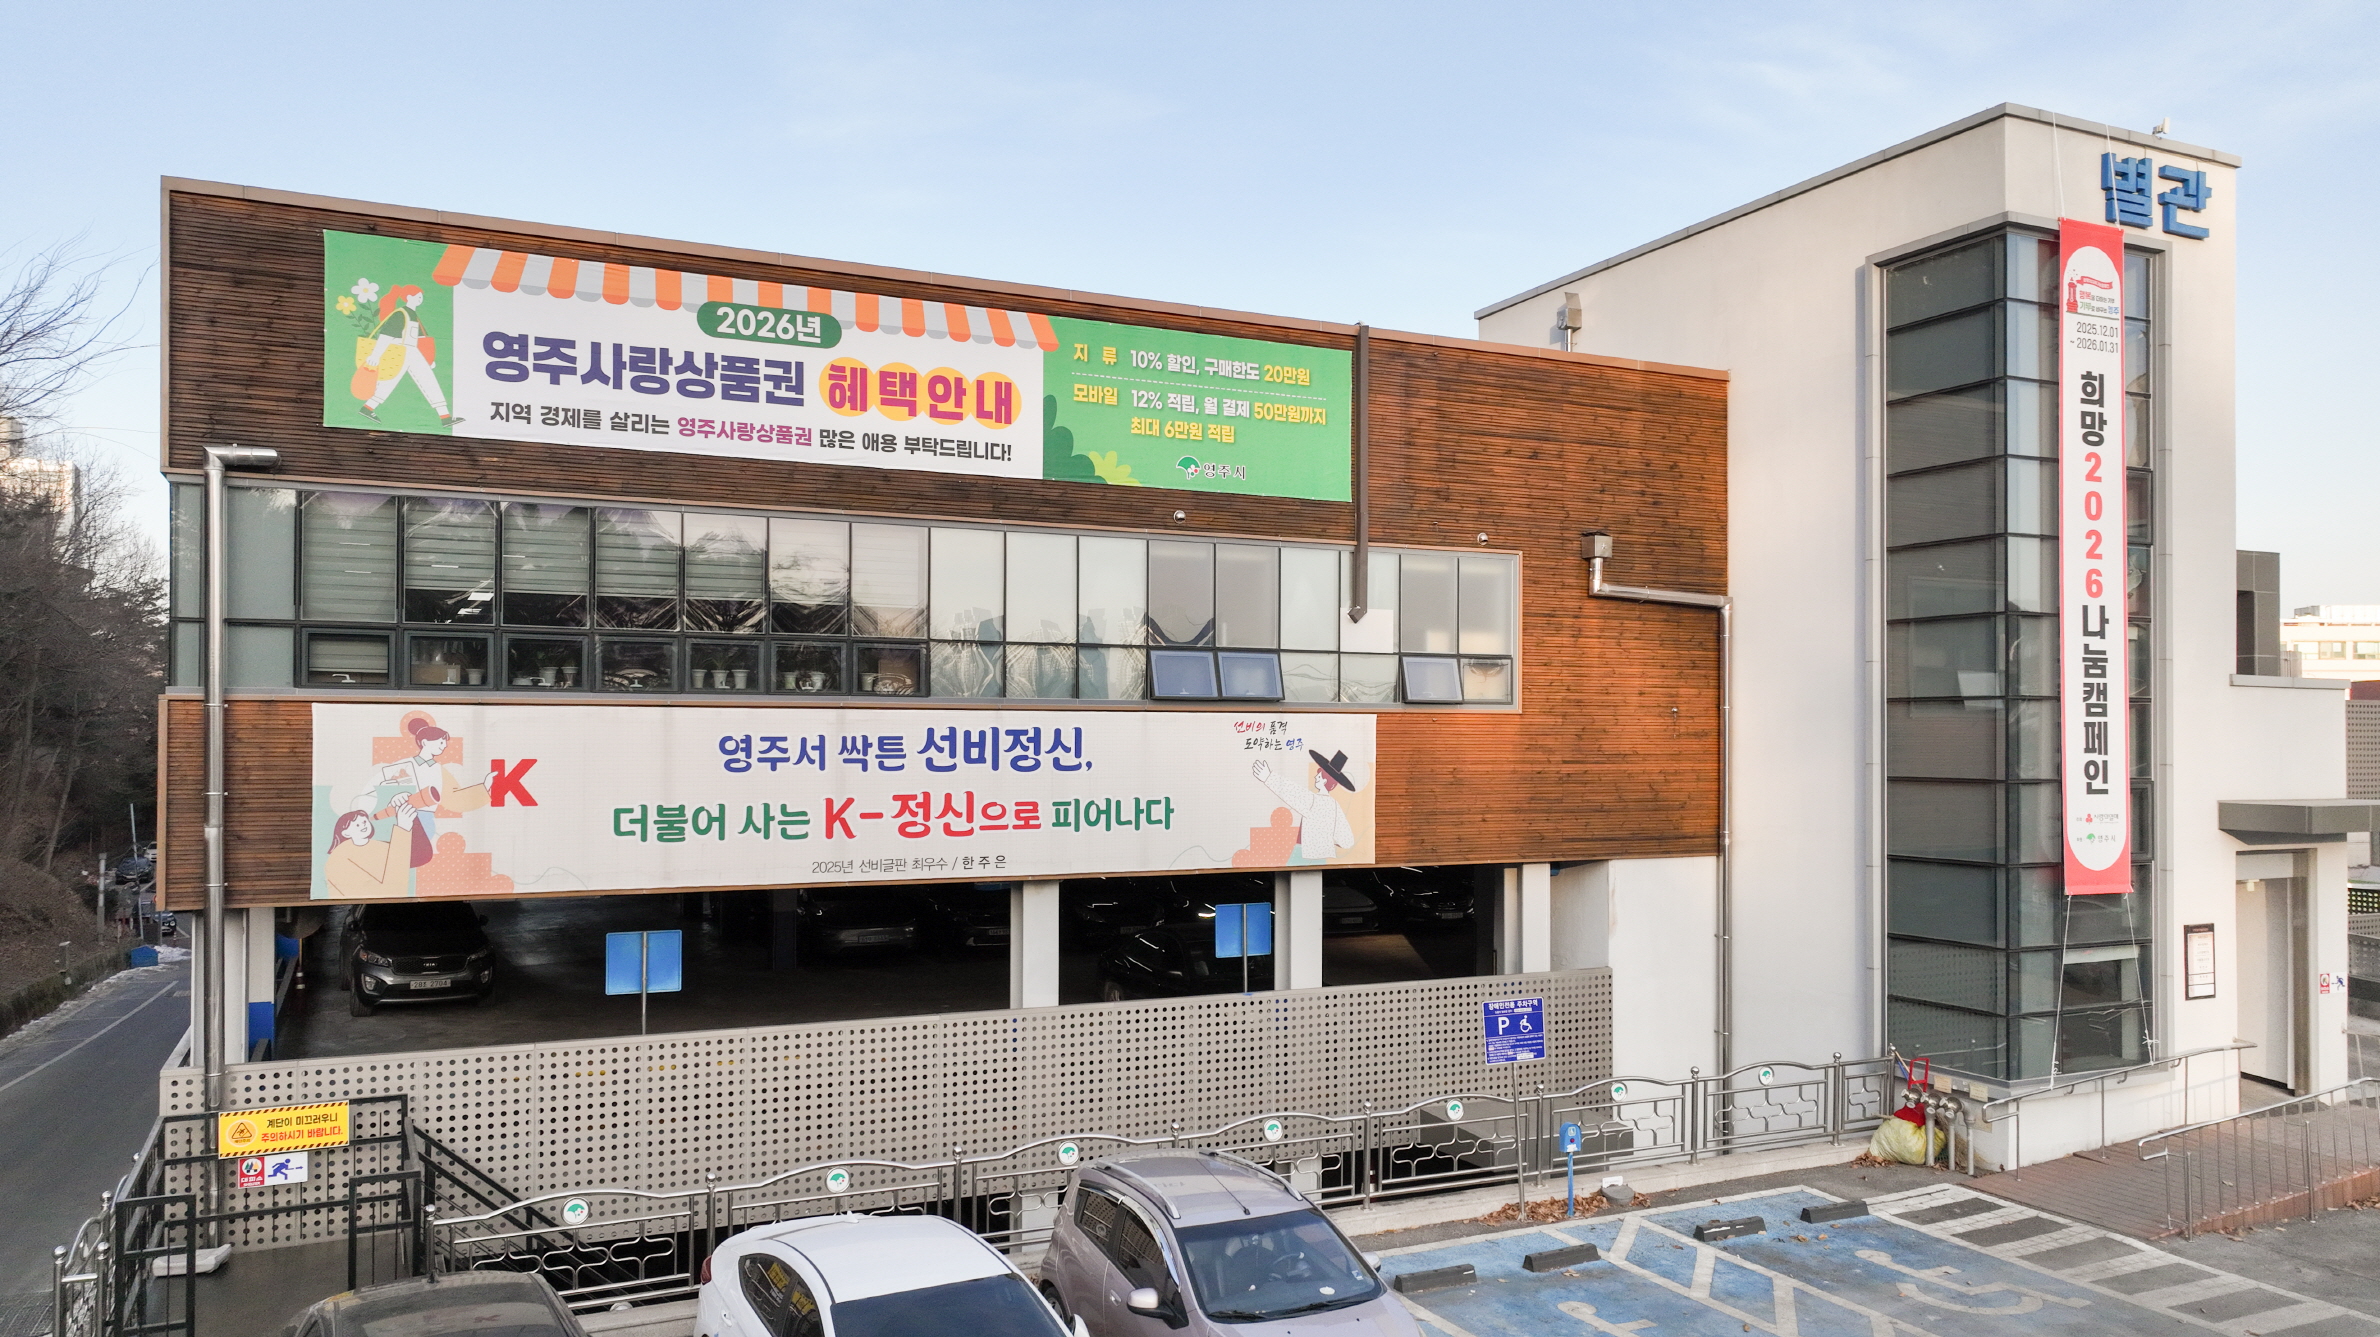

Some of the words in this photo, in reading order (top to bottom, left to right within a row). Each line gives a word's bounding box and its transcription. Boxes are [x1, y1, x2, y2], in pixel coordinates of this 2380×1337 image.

[2101, 152, 2212, 241] 별관
[716, 307, 821, 343] 2026년
[2076, 321, 2118, 338] 2025.12.01
[482, 331, 805, 406] 영주사랑상품권
[1130, 350, 1163, 370] 10%
[1167, 353, 1200, 376] 할인,
[1204, 357, 1260, 380] 구매한도
[1264, 365, 1310, 386] 20만원
[1073, 383, 1118, 406] 모바일
[1131, 389, 1163, 410] 12%
[1167, 392, 1199, 415] 적립,
[1204, 396, 1218, 416] 월
[1222, 398, 1250, 418] 결제
[1254, 402, 1327, 426] 50만원까지
[490, 401, 531, 425] 지역
[540, 405, 602, 430] 경제를
[610, 411, 669, 435] 살리는
[677, 416, 812, 447] 영주사랑상품권
[819, 428, 855, 450] 많은
[862, 432, 897, 452] 애용
[904, 435, 1012, 462] 부탁드립니다!
[1131, 417, 1160, 437] 최대
[1164, 420, 1203, 440] 6만원
[1207, 423, 1235, 443] 적립
[1203, 463, 1246, 480] 영주시
[1233, 721, 1266, 733] 선비의
[1269, 721, 1288, 735] 품격
[718, 734, 826, 773] 영주서
[837, 734, 906, 772] 싹튼
[916, 725, 1093, 773] 선비정신,
[1244, 737, 1282, 751] 도약하는
[1285, 738, 1304, 751] 영주
[491, 758, 538, 807] K
[613, 803, 726, 843] 더불어
[737, 802, 811, 841] 사는
[1052, 796, 1174, 833] 피어나다
[811, 860, 854, 874] 2025년
[858, 857, 908, 873] 선비글판
[911, 857, 948, 872] 최우수
[1498, 1016, 1510, 1035] P
[261, 1129, 304, 1143] 주의하시기
[307, 1125, 344, 1138] 바랍니다.
[266, 1117, 293, 1129] 계단이
[296, 1112, 338, 1126] 미끄러우니
